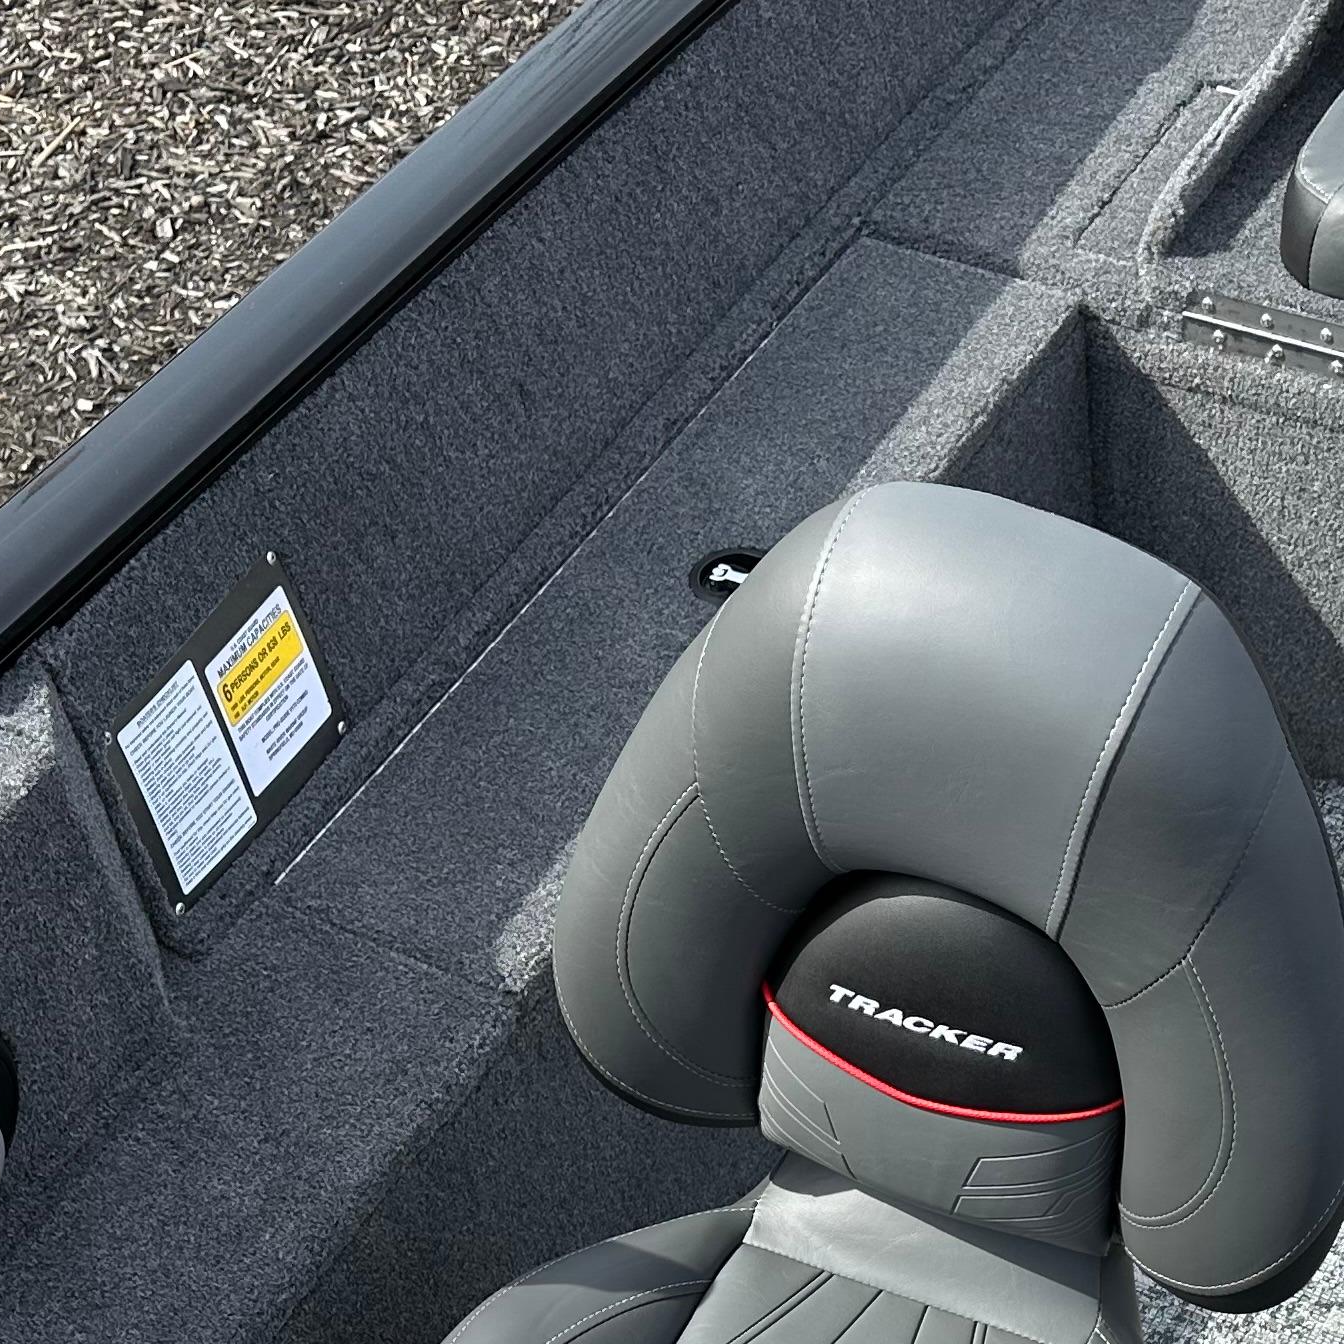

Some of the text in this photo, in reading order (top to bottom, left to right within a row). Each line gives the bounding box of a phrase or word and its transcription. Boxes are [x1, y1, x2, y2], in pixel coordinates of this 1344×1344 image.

[216, 602, 281, 679] MAXIMUM CAPACITIES
[221, 681, 233, 704] 6
[229, 656, 258, 694] PERSONS
[257, 646, 268, 663] OR
[277, 620, 291, 640] LBS
[829, 983, 1023, 1062] TRACKER
